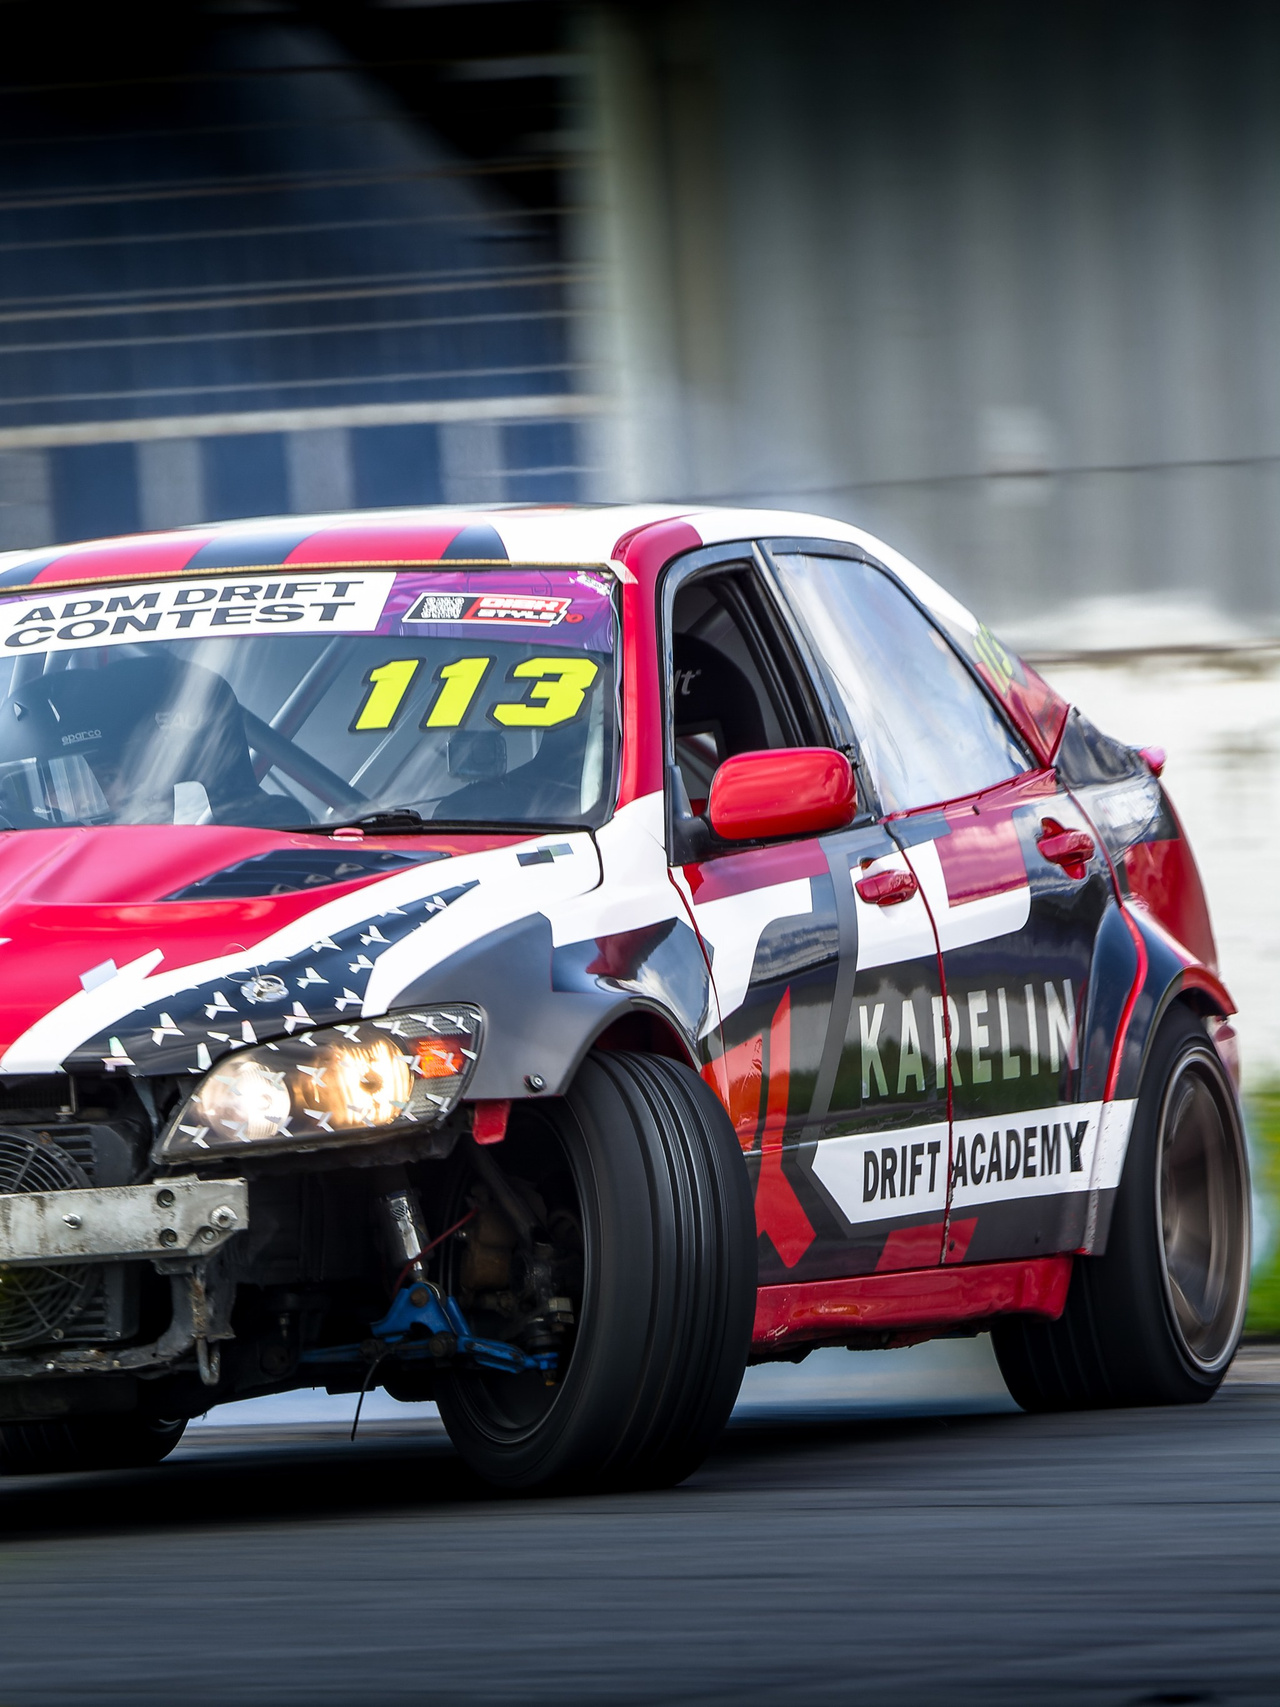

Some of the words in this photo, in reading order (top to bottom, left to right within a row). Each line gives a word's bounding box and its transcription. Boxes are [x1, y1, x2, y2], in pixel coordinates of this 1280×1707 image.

[4, 601, 356, 648] CONTEST
[14, 592, 161, 626] ADM
[173, 581, 364, 606] DRIFT
[353, 656, 601, 731] 113
[61, 729, 102, 746] sparco
[859, 978, 1080, 1099] KARELIN
[862, 1140, 941, 1203] DRIFT
[951, 1120, 1090, 1190] ACADEMY
